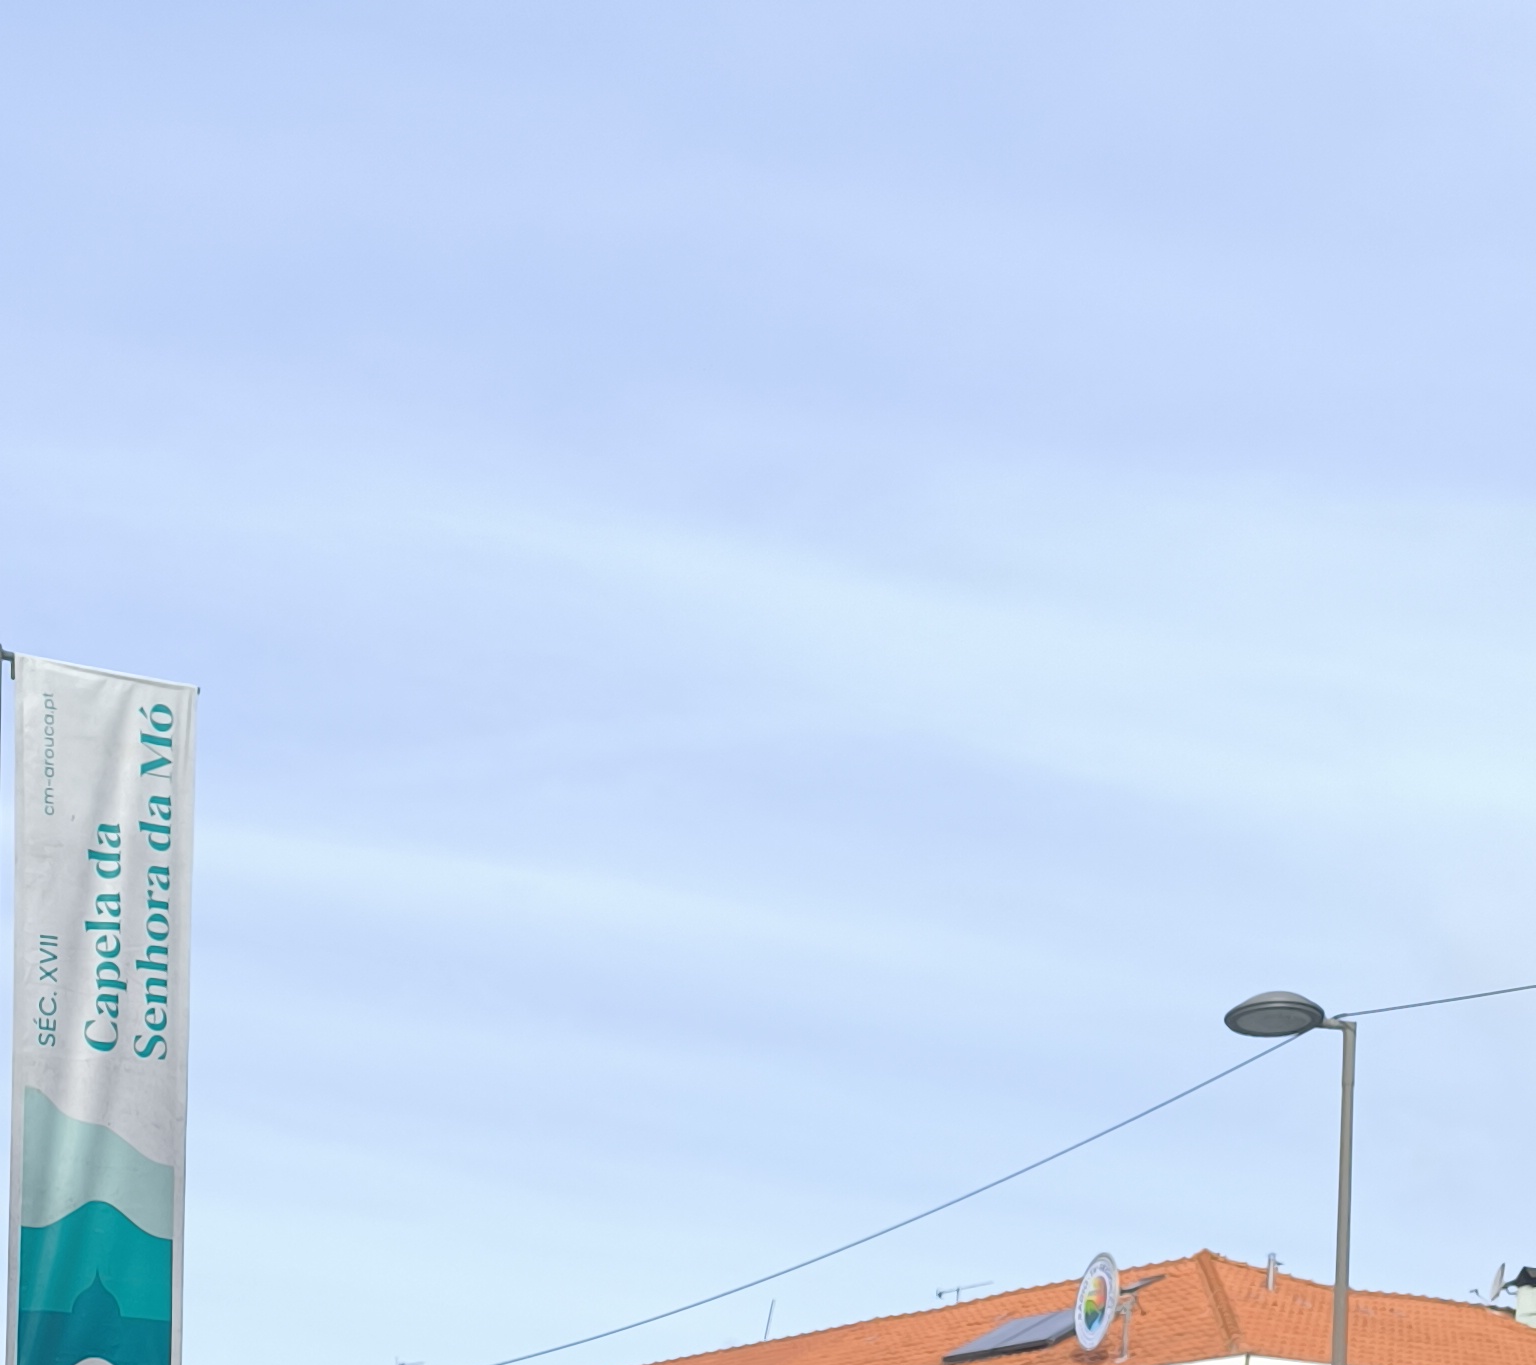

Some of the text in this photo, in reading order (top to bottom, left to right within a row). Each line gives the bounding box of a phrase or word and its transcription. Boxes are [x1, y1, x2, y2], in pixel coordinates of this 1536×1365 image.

[43, 692, 57, 816] cm-arouca.pt
[84, 822, 128, 1053] Capela da
[133, 702, 174, 1061] Senhora da Mó
[38, 934, 59, 1047] SÉC. XVII
